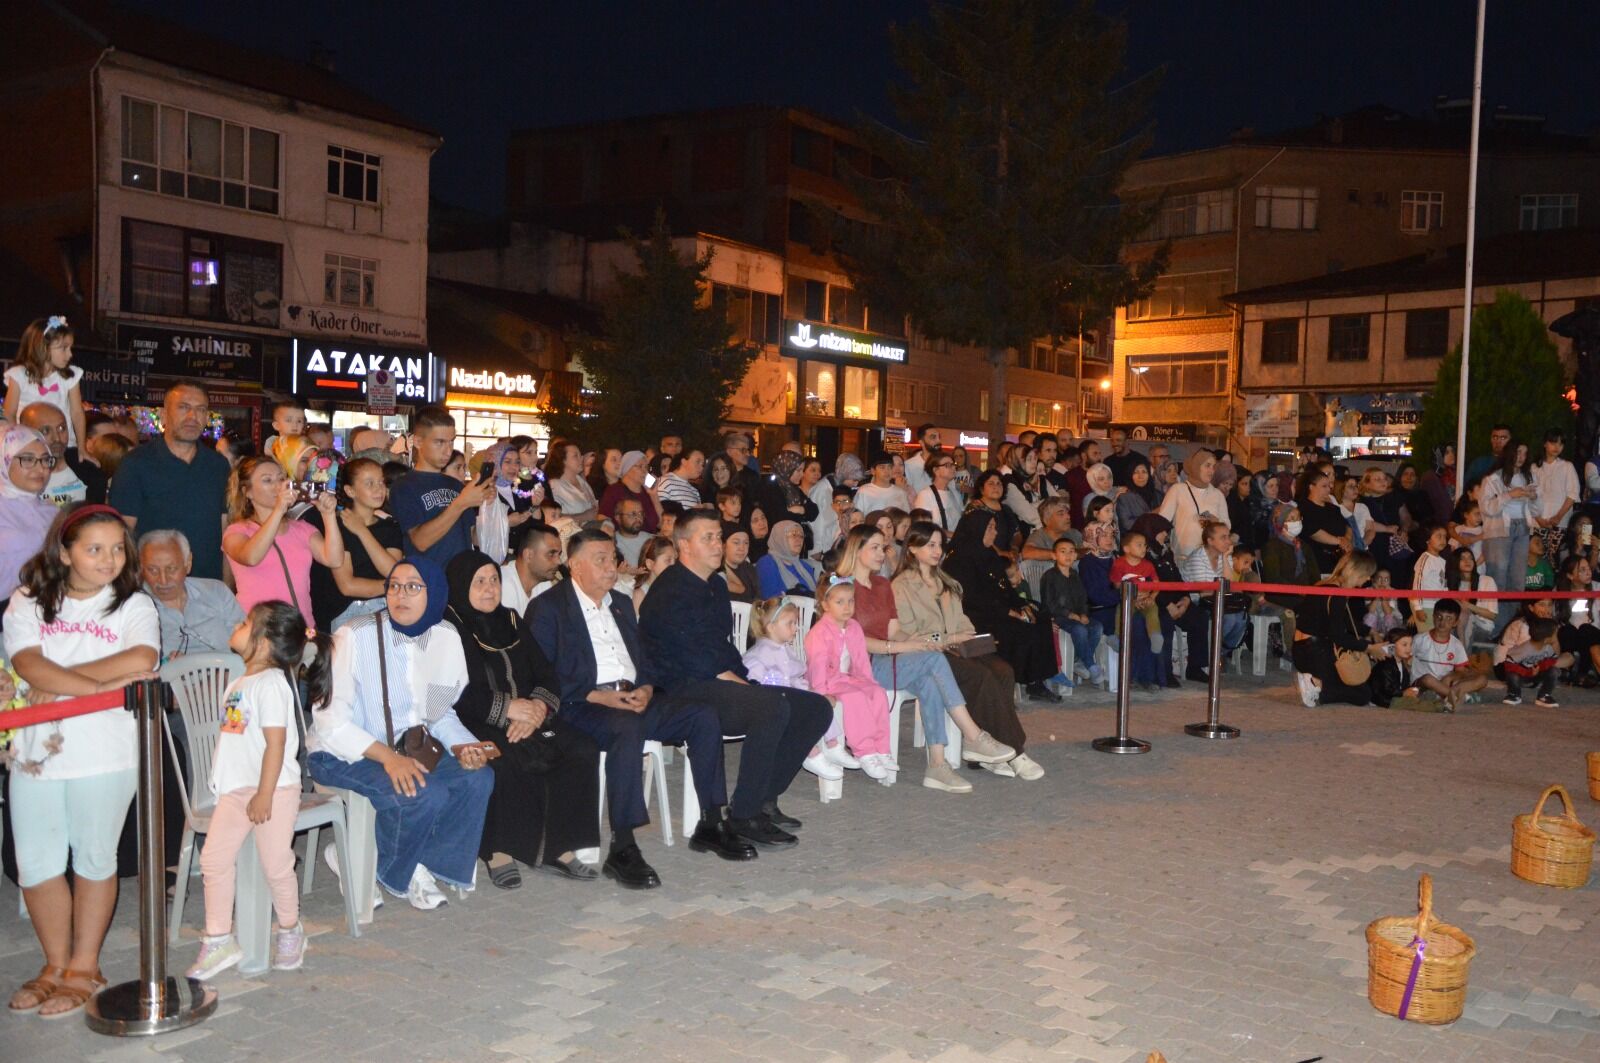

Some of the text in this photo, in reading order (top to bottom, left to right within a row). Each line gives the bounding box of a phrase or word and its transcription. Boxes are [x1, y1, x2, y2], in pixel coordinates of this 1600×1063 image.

[307, 310, 381, 335] Kader Öner
[171, 336, 252, 357] ŞAHİNLER
[306, 348, 423, 380] ATAKAN
[451, 367, 537, 395] Nazlı Optik
